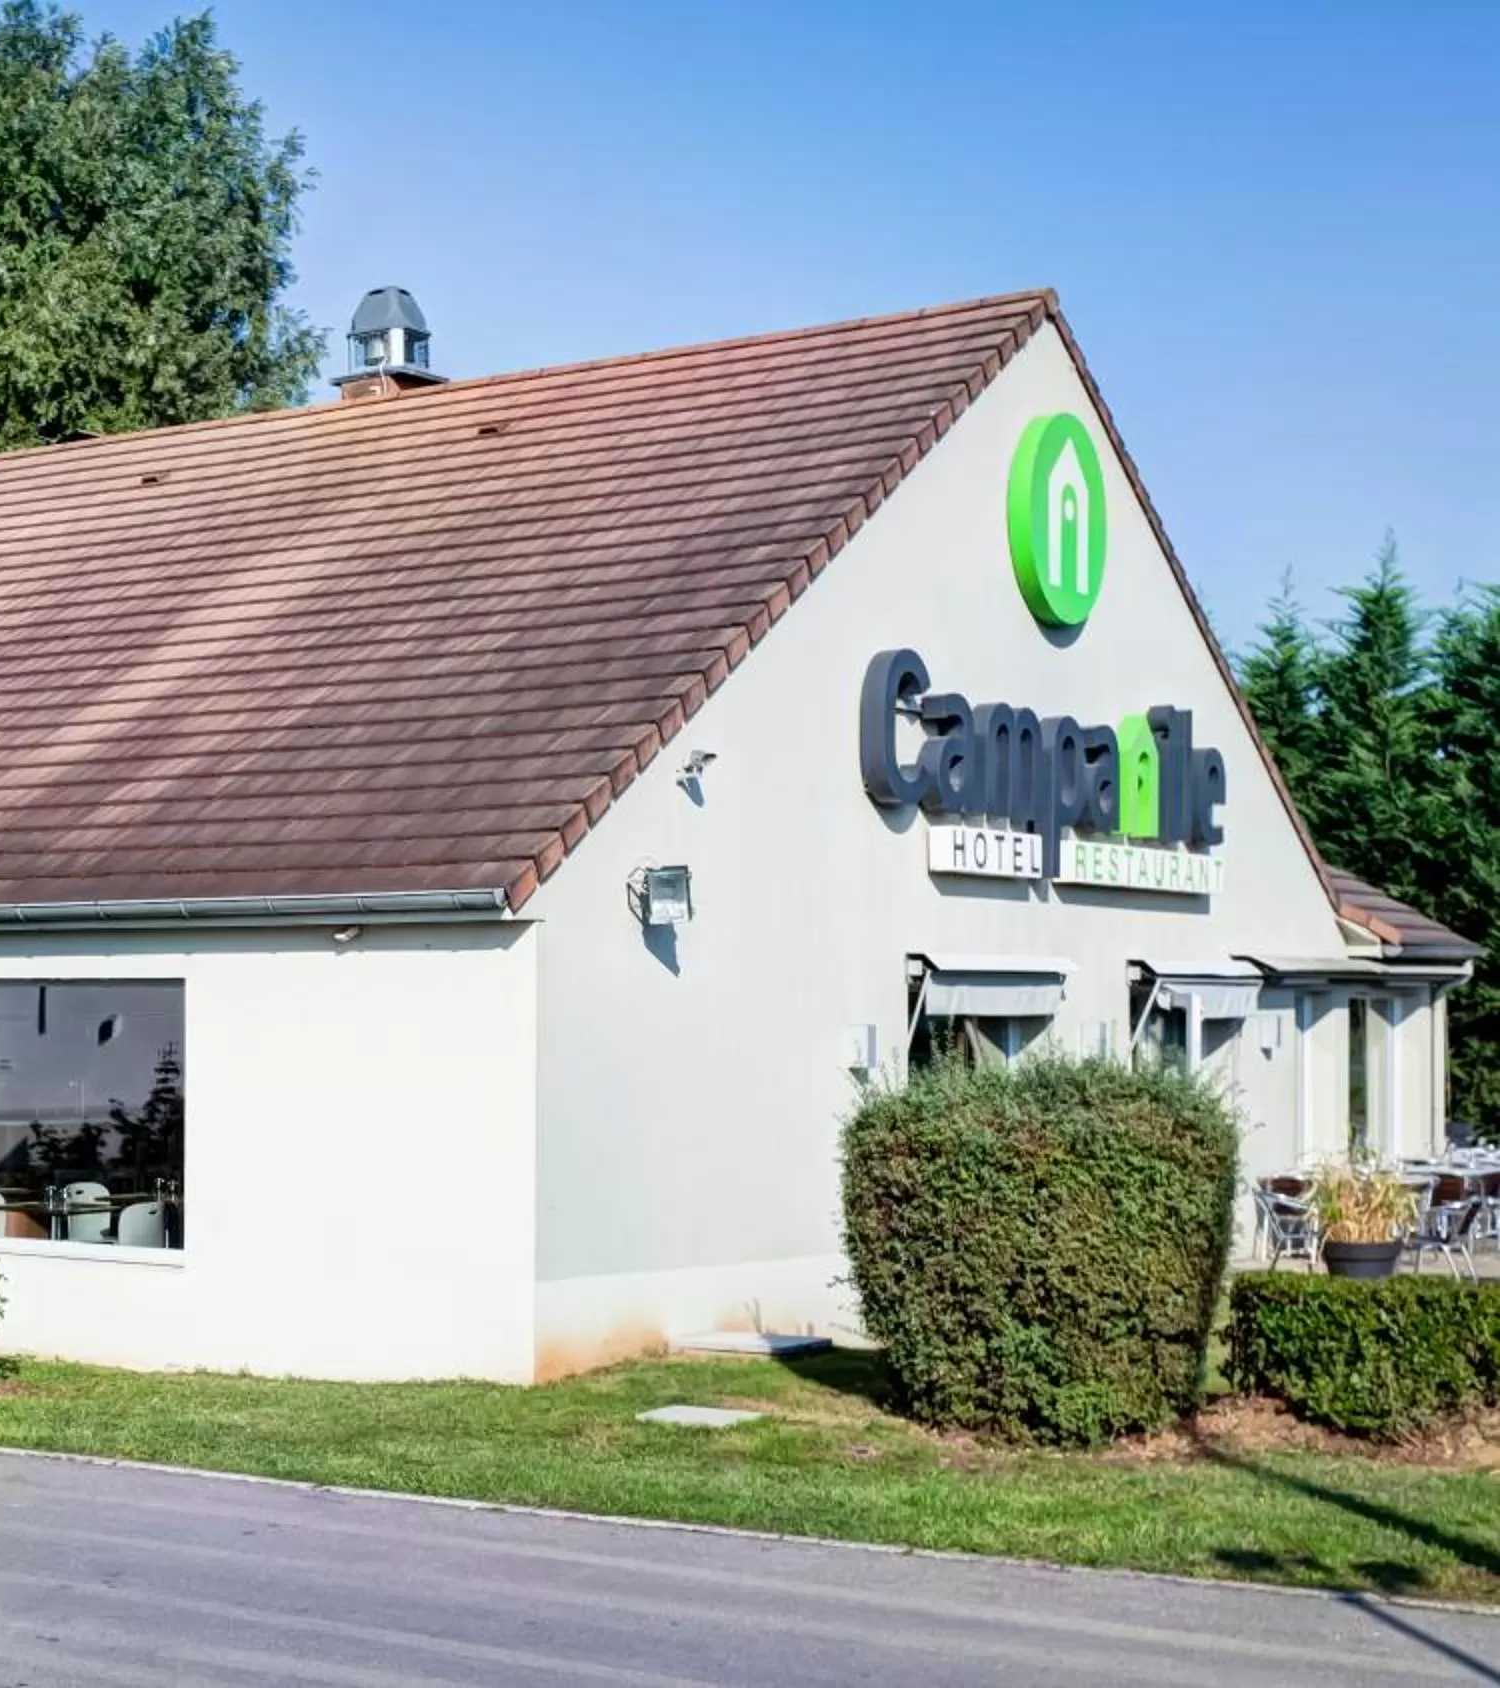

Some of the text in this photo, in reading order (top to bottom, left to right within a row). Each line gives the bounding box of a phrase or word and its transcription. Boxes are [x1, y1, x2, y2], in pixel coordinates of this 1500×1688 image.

[860, 648, 1226, 878] Campanile
[953, 832, 1041, 874] HOTEL
[1074, 843, 1225, 892] RESTAURANT
